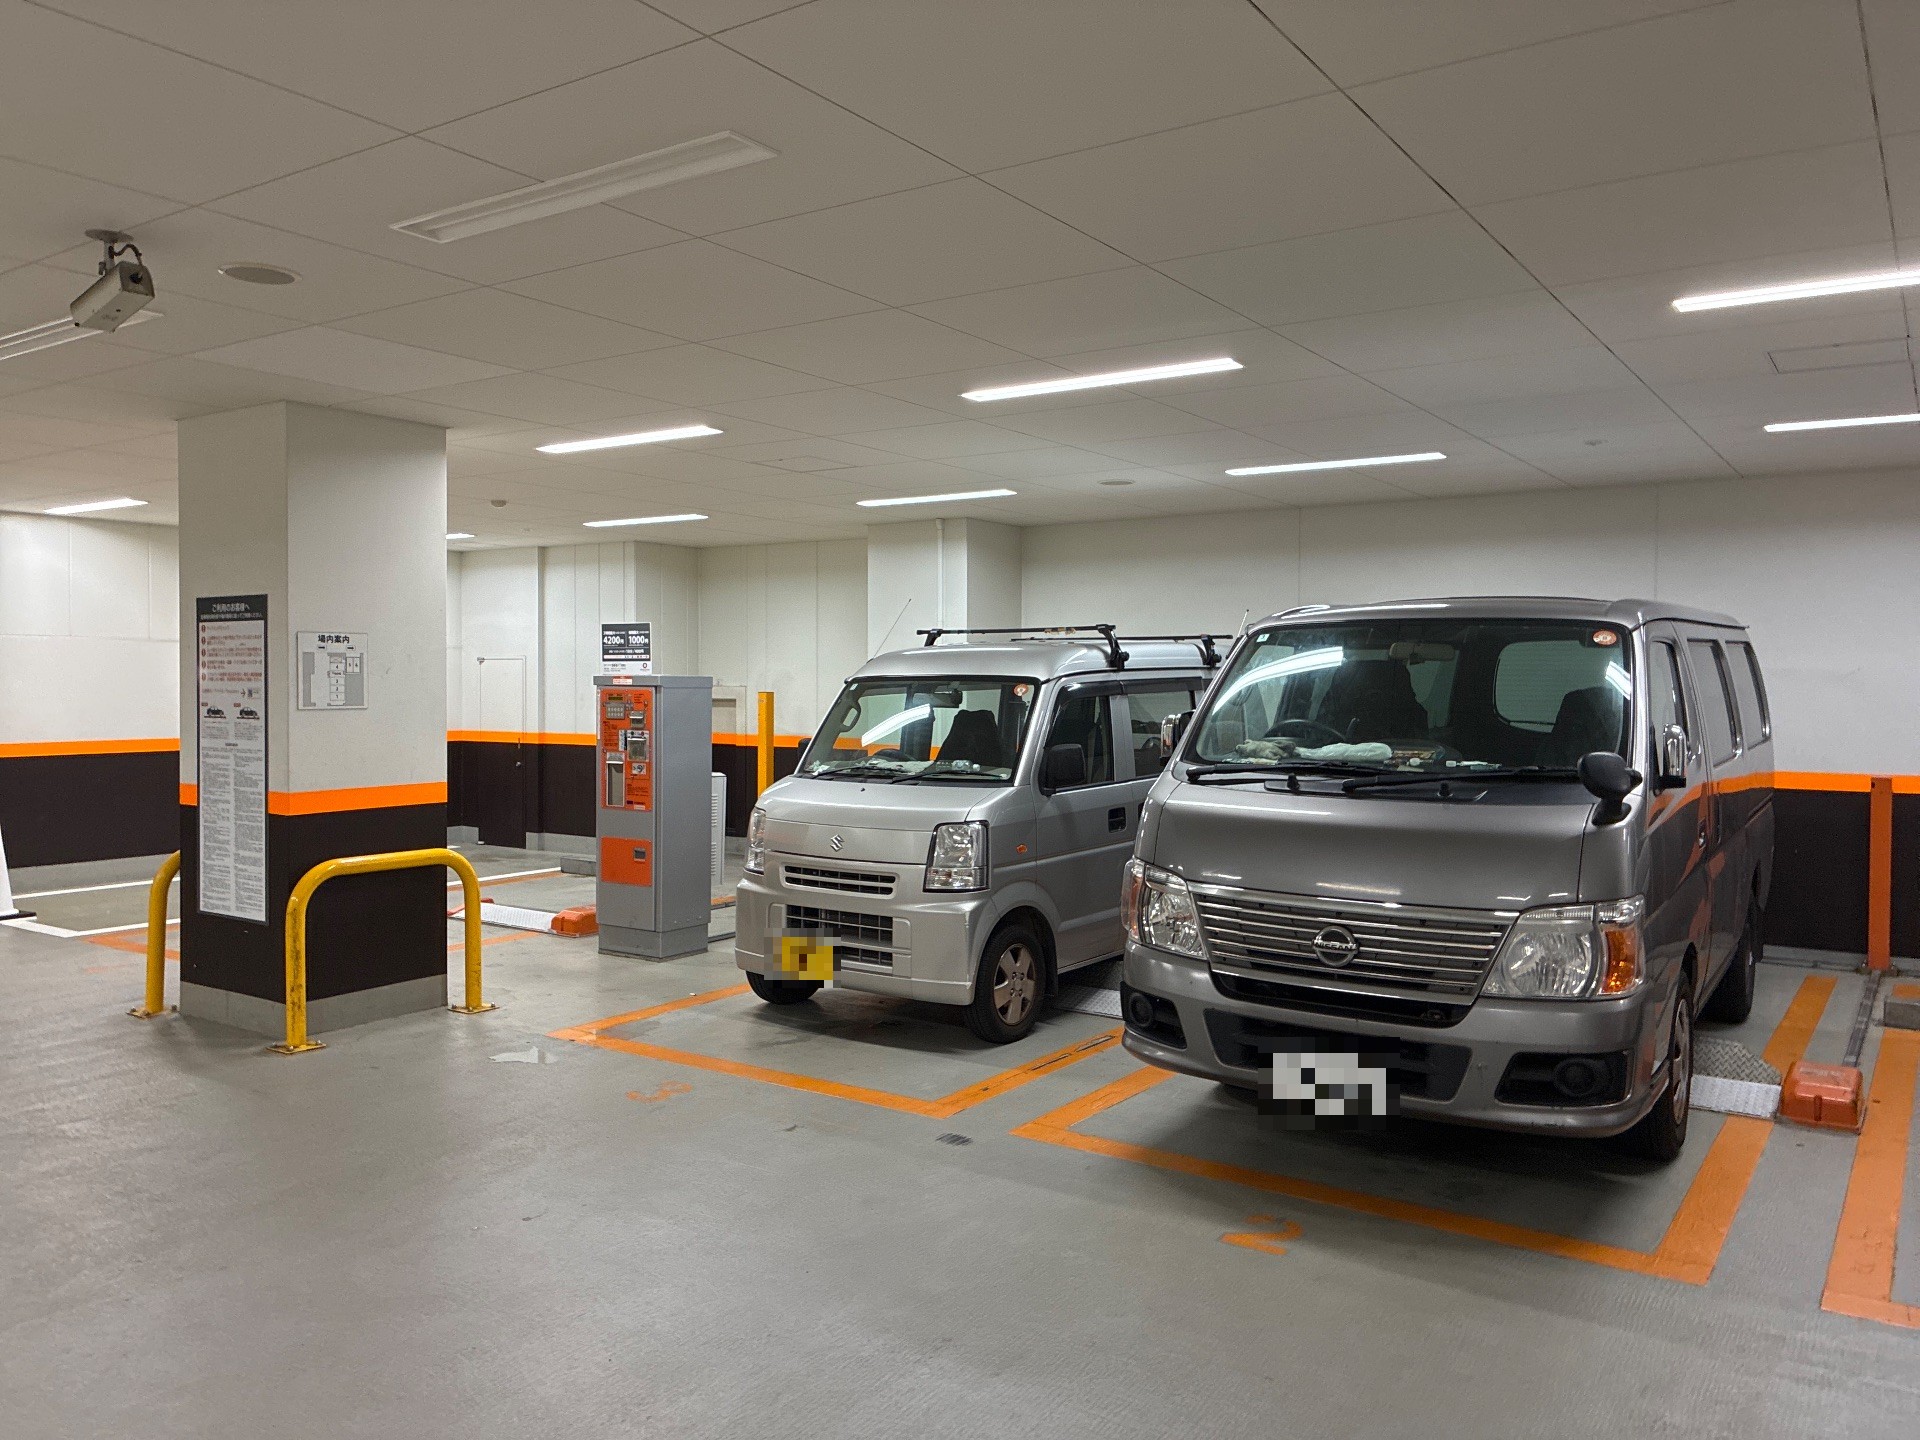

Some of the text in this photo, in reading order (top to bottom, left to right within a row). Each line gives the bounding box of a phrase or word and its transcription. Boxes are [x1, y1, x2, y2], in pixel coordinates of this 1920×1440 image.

[317, 634, 350, 644] 場内案内
[603, 635, 625, 645] 4200円
[628, 635, 649, 645] 1000円
[1220, 1212, 1304, 1255] 2
